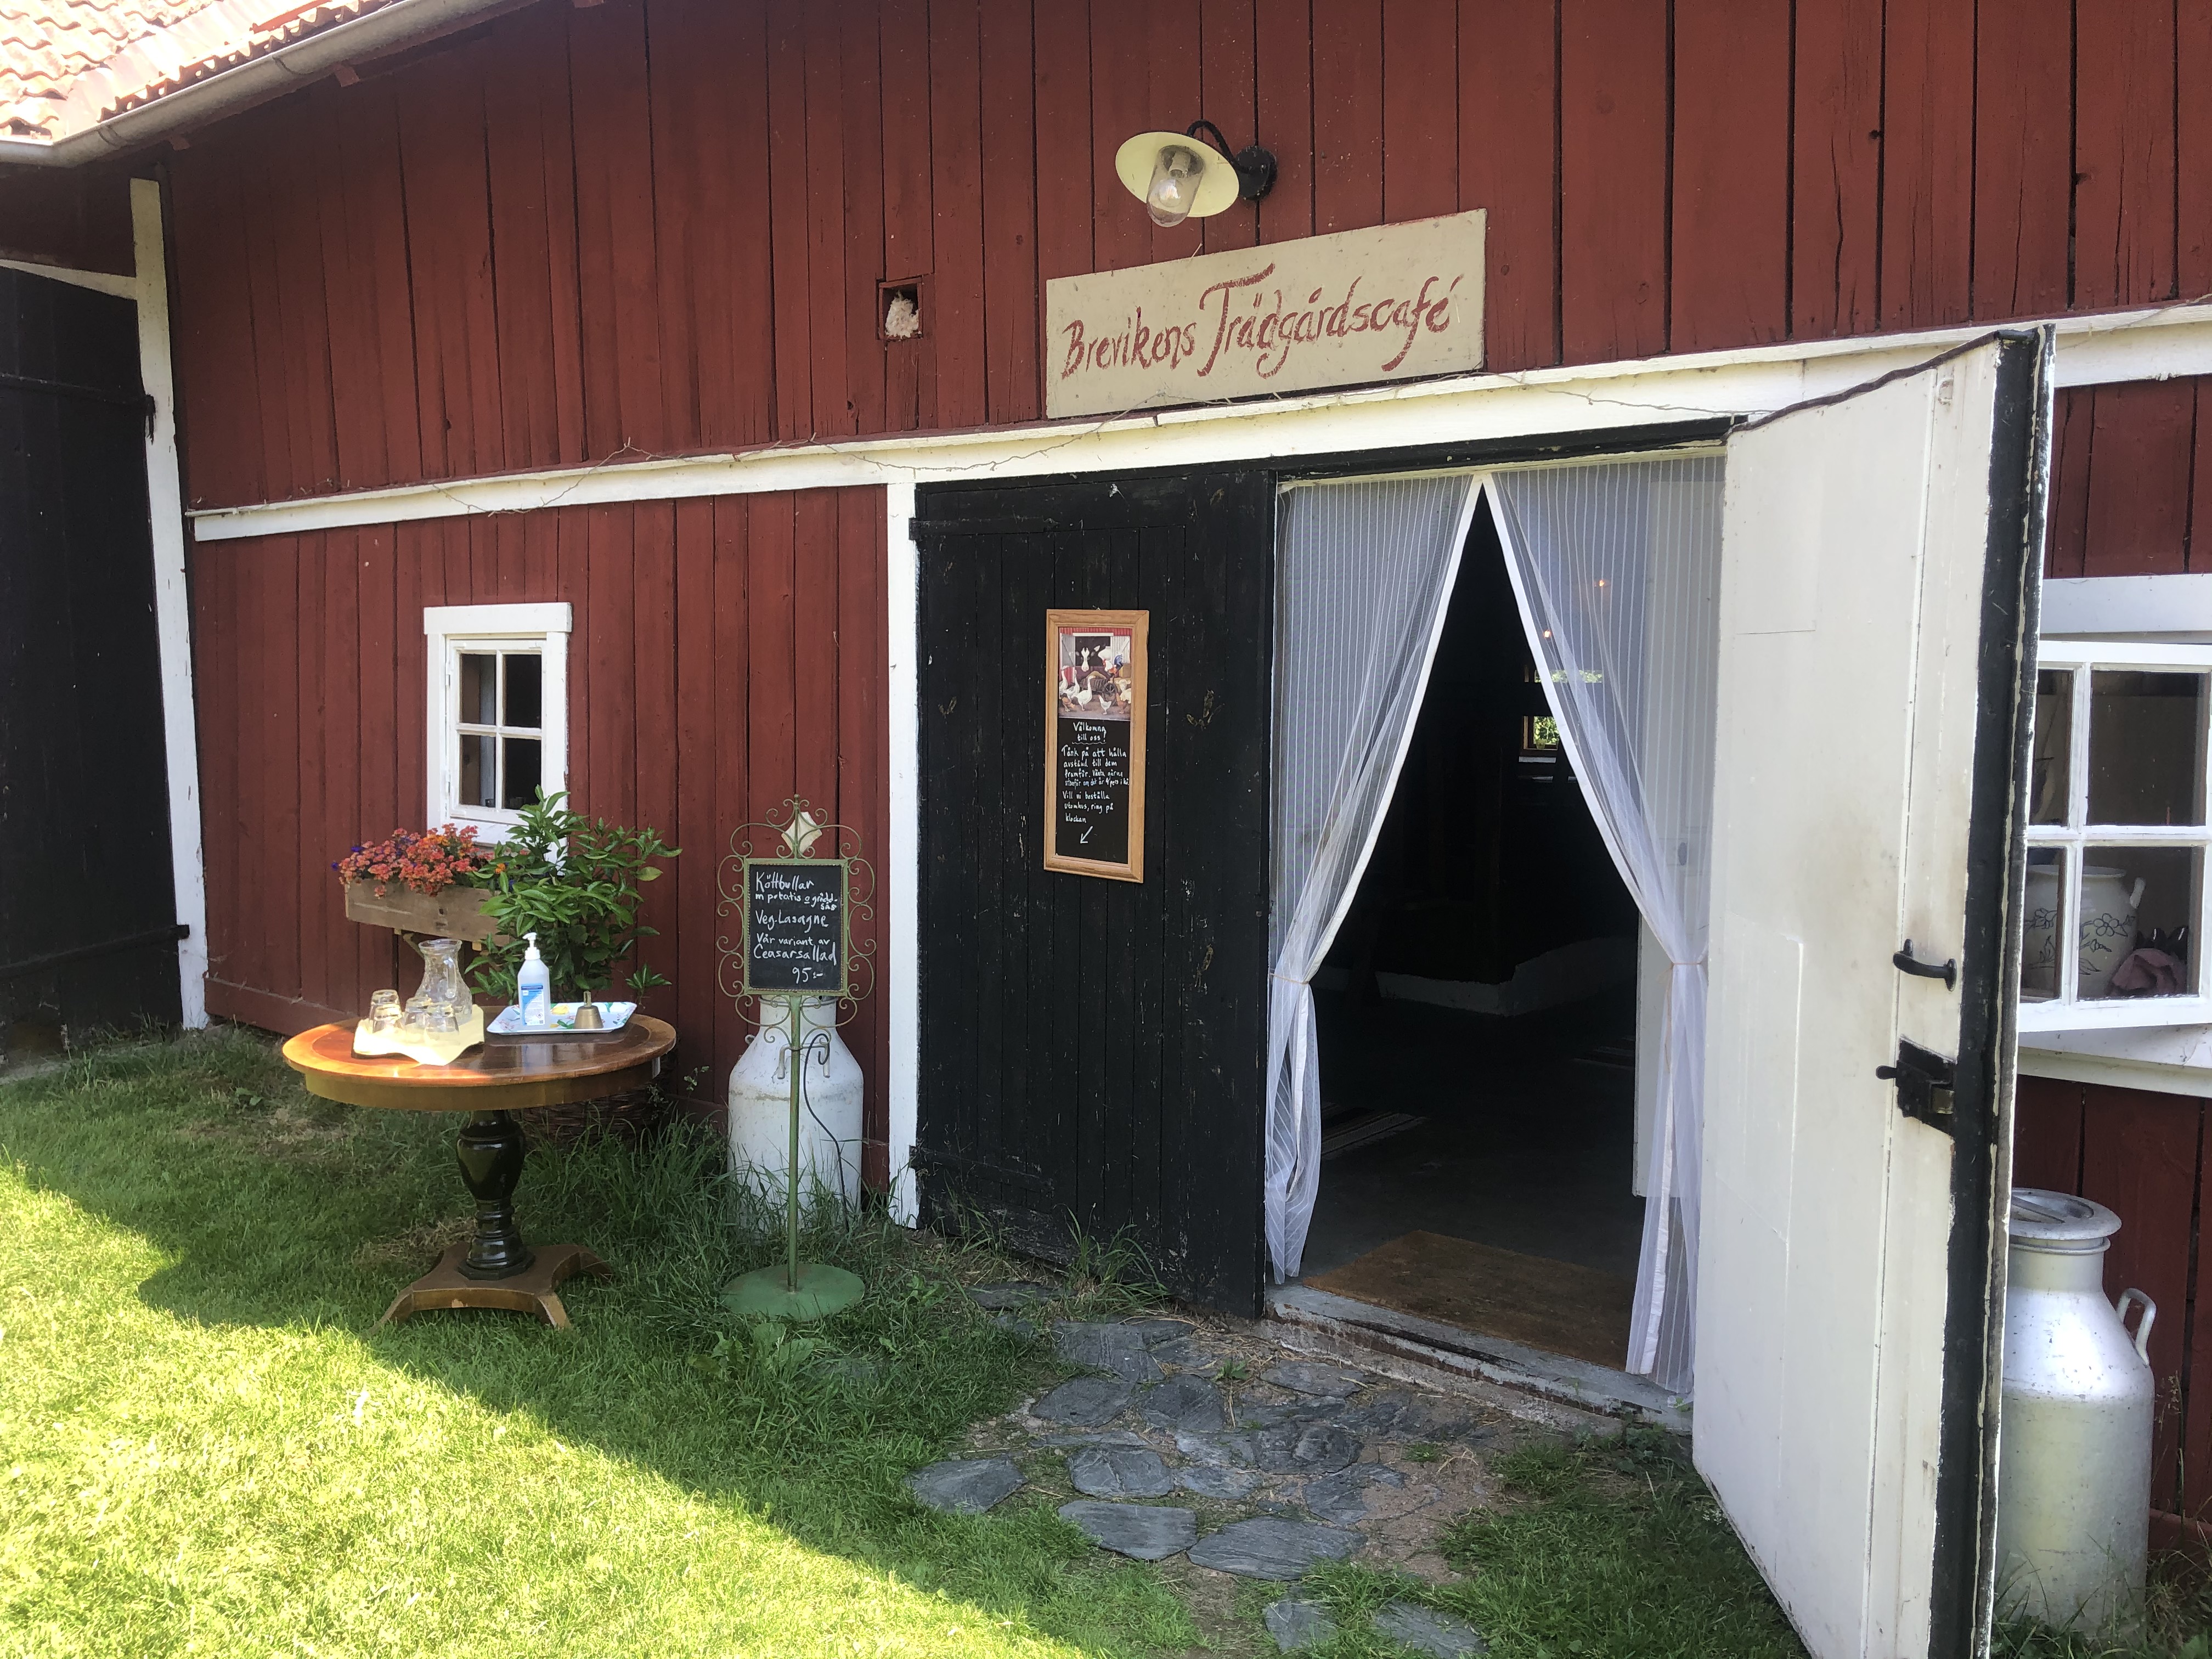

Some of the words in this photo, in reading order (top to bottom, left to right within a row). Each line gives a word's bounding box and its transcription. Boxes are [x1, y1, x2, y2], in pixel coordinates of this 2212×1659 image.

[1060, 305, 1197, 380] Brevikens
[1197, 262, 1465, 380] Trädgårdscafé
[1061, 744, 1079, 757] Tänk
[1081, 747, 1089, 760] på
[1092, 748, 1105, 757] att
[1109, 747, 1126, 757] hålla
[1063, 758, 1088, 768] avstånd
[1092, 758, 1101, 767] till
[1105, 758, 1118, 767] dem
[1098, 777, 1104, 785] är
[1063, 790, 1073, 799] Vill
[1085, 790, 1110, 799] beställa
[1091, 803, 1103, 814] ring
[1105, 803, 1114, 814] på
[1065, 812, 1086, 823] klockan
[756, 871, 815, 893] Köttbullar
[767, 891, 802, 904] potatis
[757, 932, 776, 944] Vår
[778, 936, 814, 946] variant
[753, 941, 837, 966] Ceasarsallad
